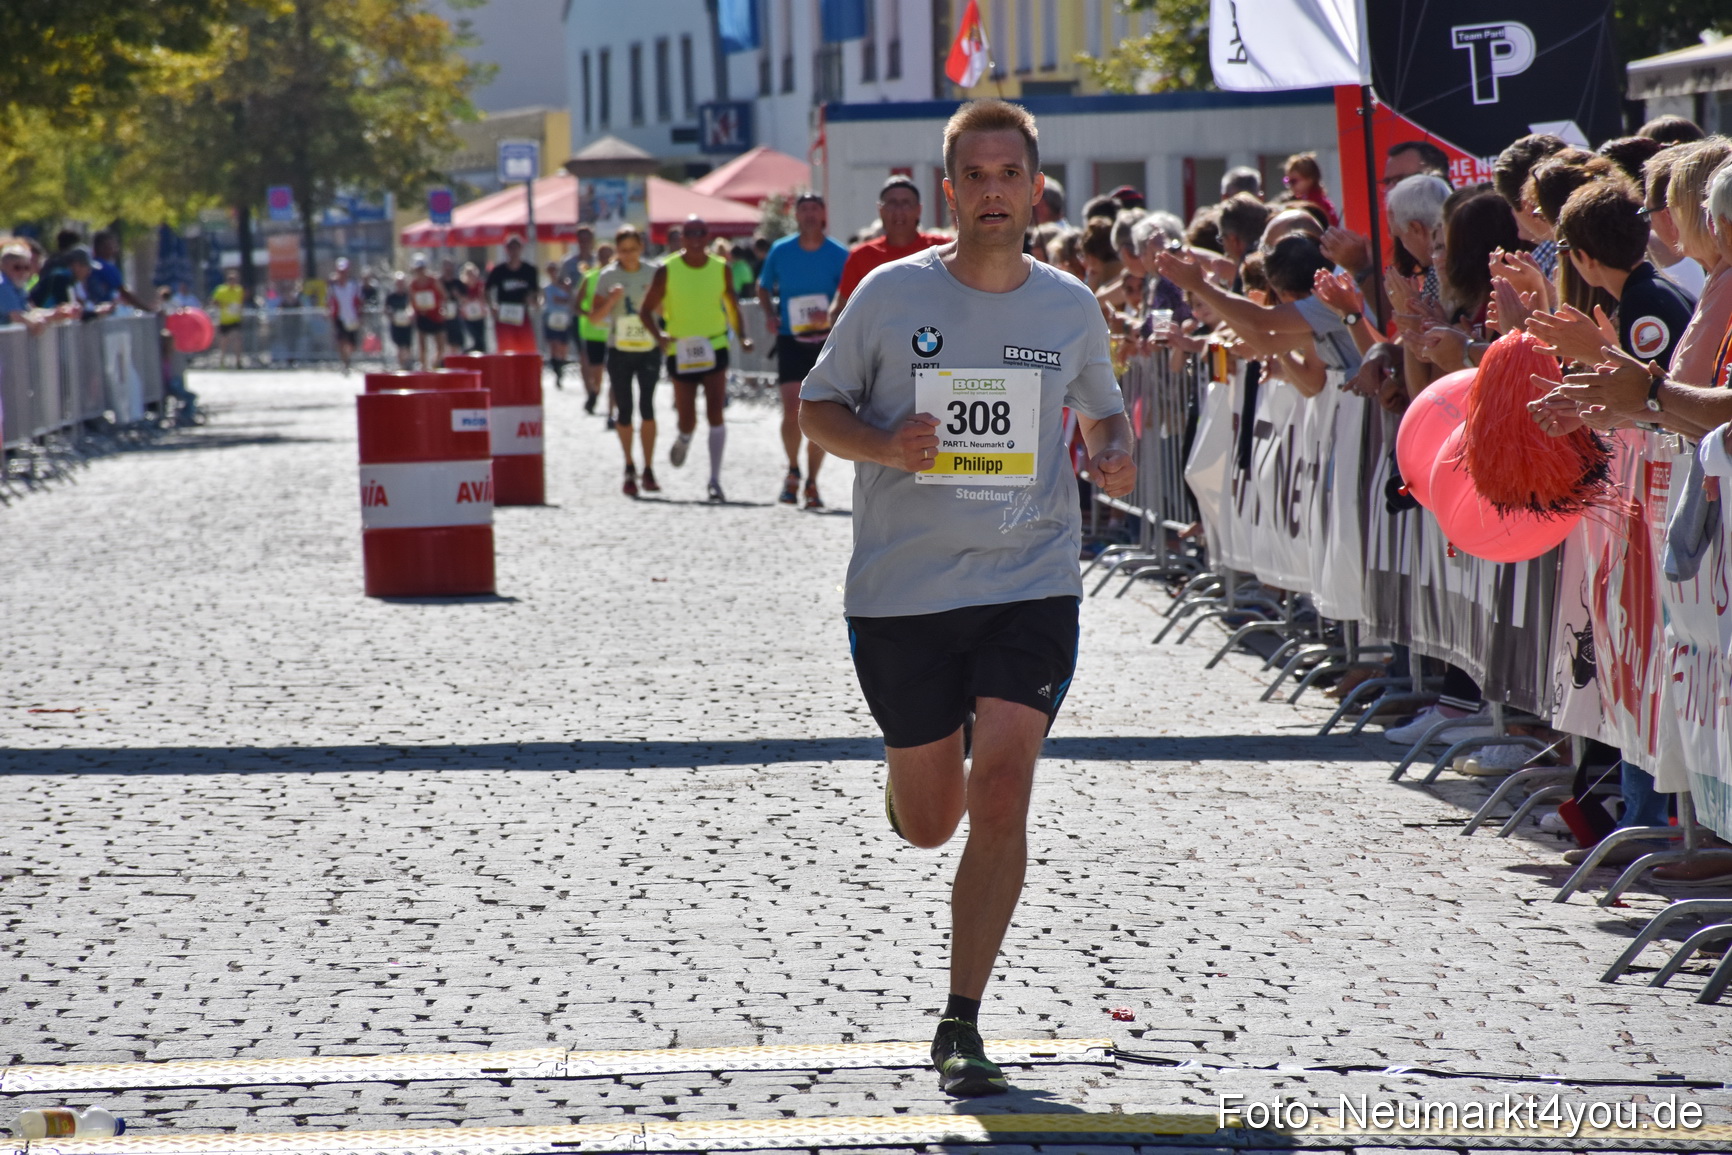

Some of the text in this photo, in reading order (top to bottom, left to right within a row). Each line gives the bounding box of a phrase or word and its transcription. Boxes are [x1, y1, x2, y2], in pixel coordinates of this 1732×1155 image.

[1458, 32, 1482, 41] Team
[1003, 345, 1061, 366] BOCK
[953, 378, 1006, 391] BOCK
[946, 400, 1011, 436] 308
[942, 440, 969, 448] PARTL
[953, 456, 1003, 475] Philipp
[955, 488, 1015, 504] Stadtlauf
